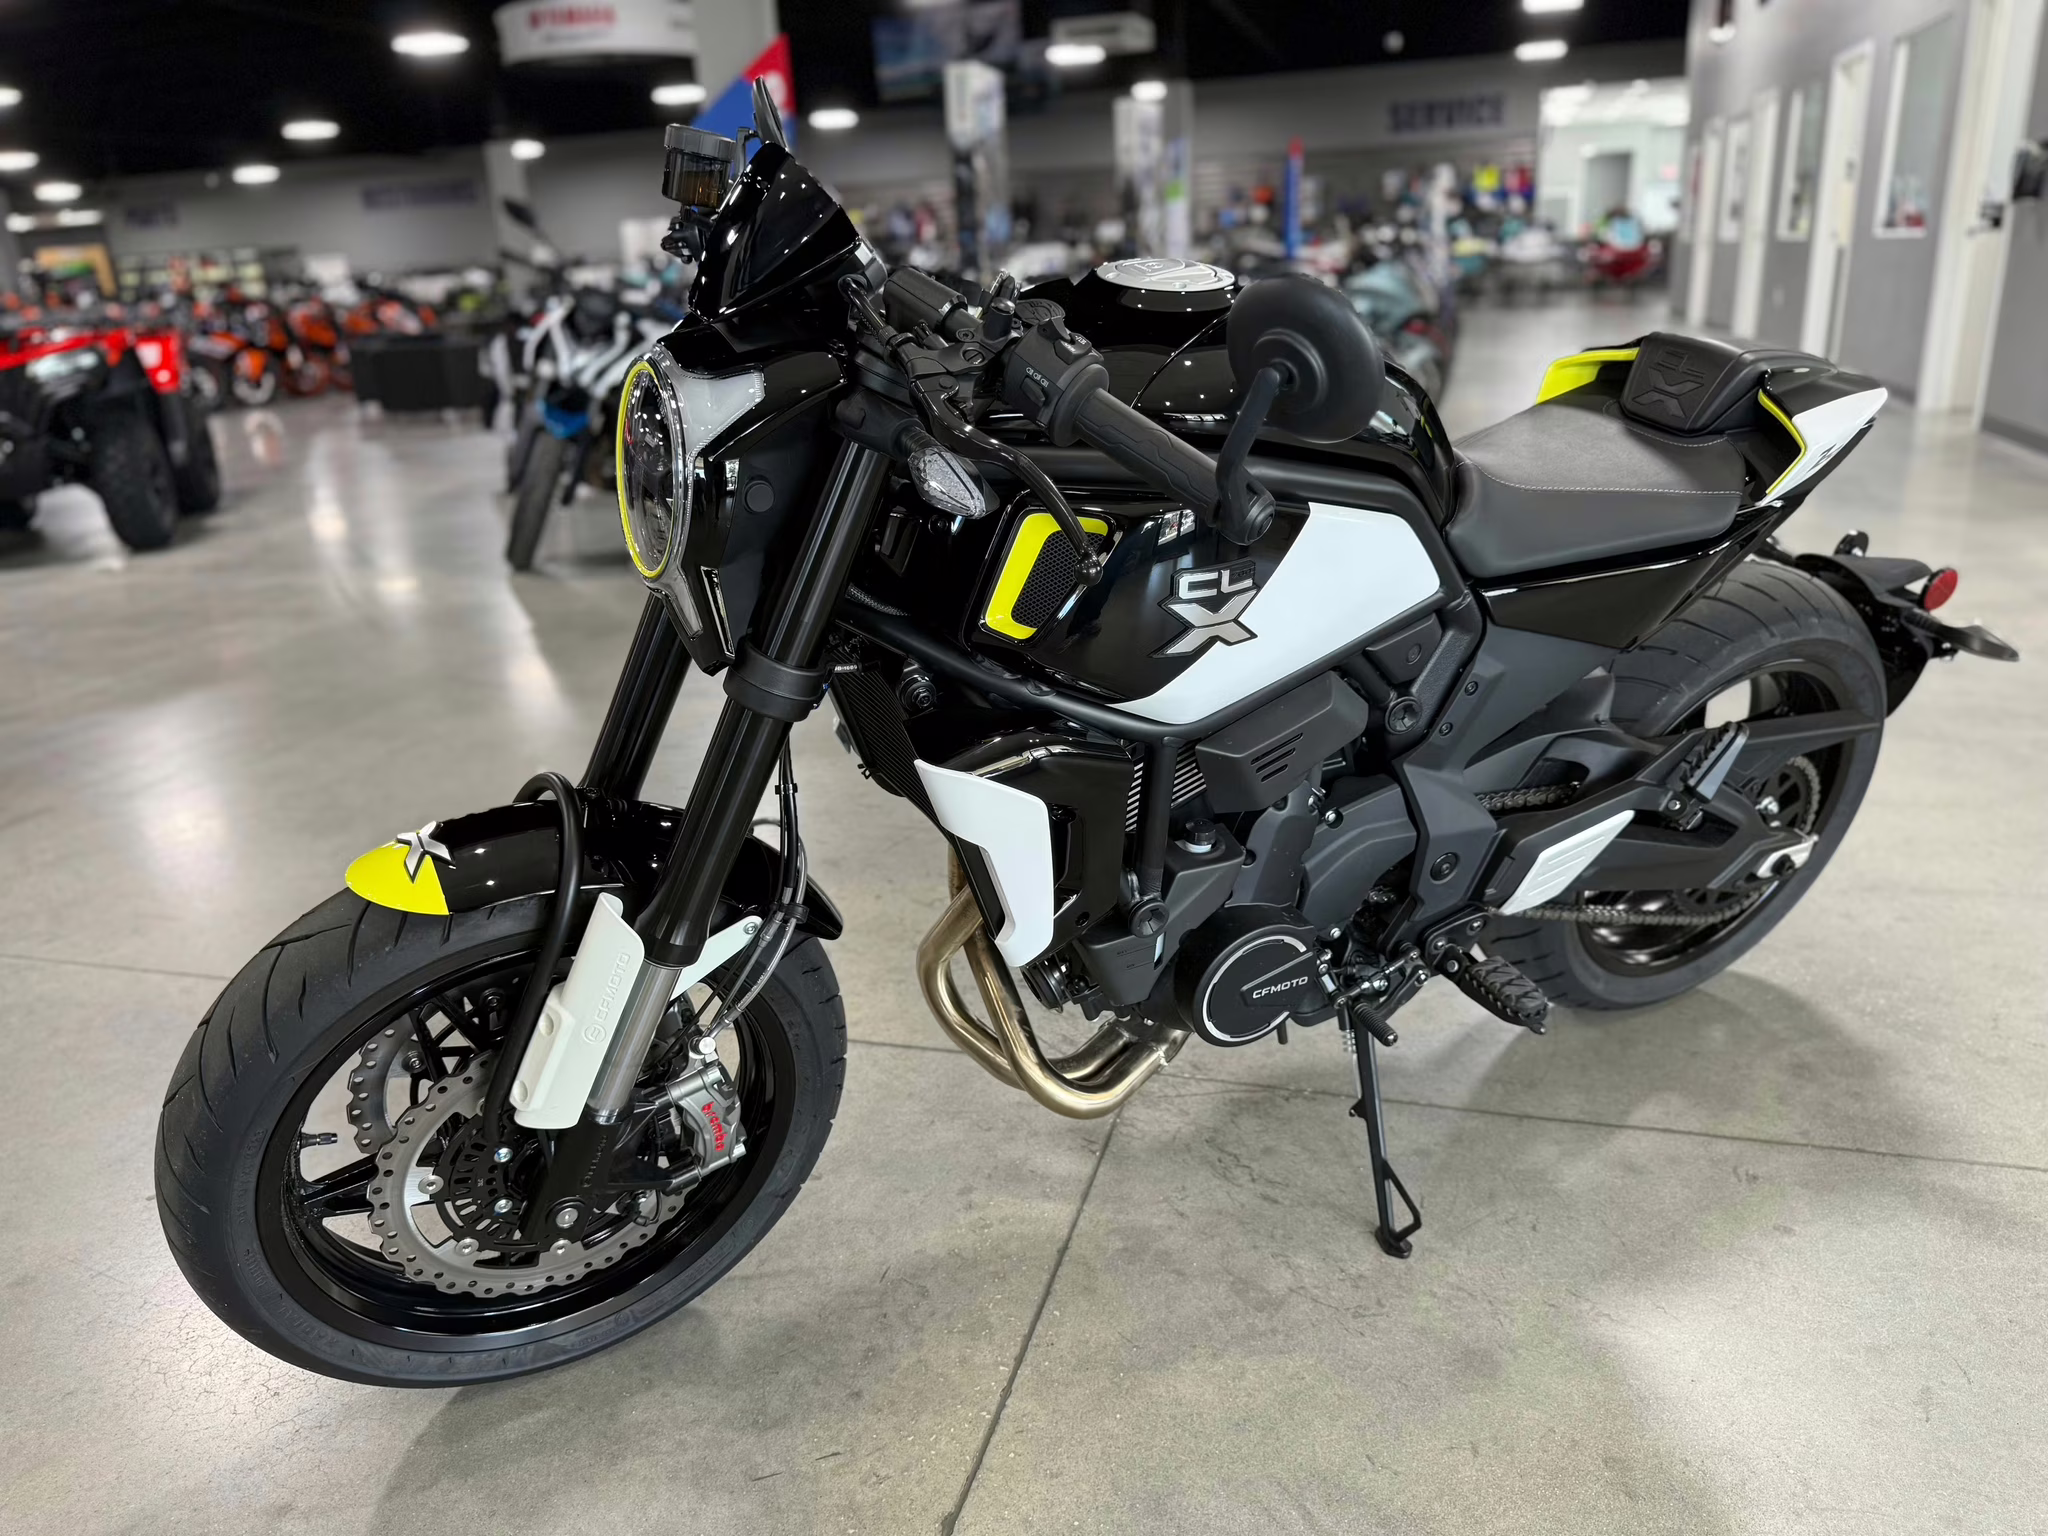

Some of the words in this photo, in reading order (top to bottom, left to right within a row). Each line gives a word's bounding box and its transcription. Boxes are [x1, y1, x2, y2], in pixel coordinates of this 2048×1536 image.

[1389, 95, 1506, 132] SERVICE
[594, 951, 631, 1021] CFMOTO
[1252, 976, 1309, 999] CFMOTO
[702, 1101, 728, 1152] brembo
